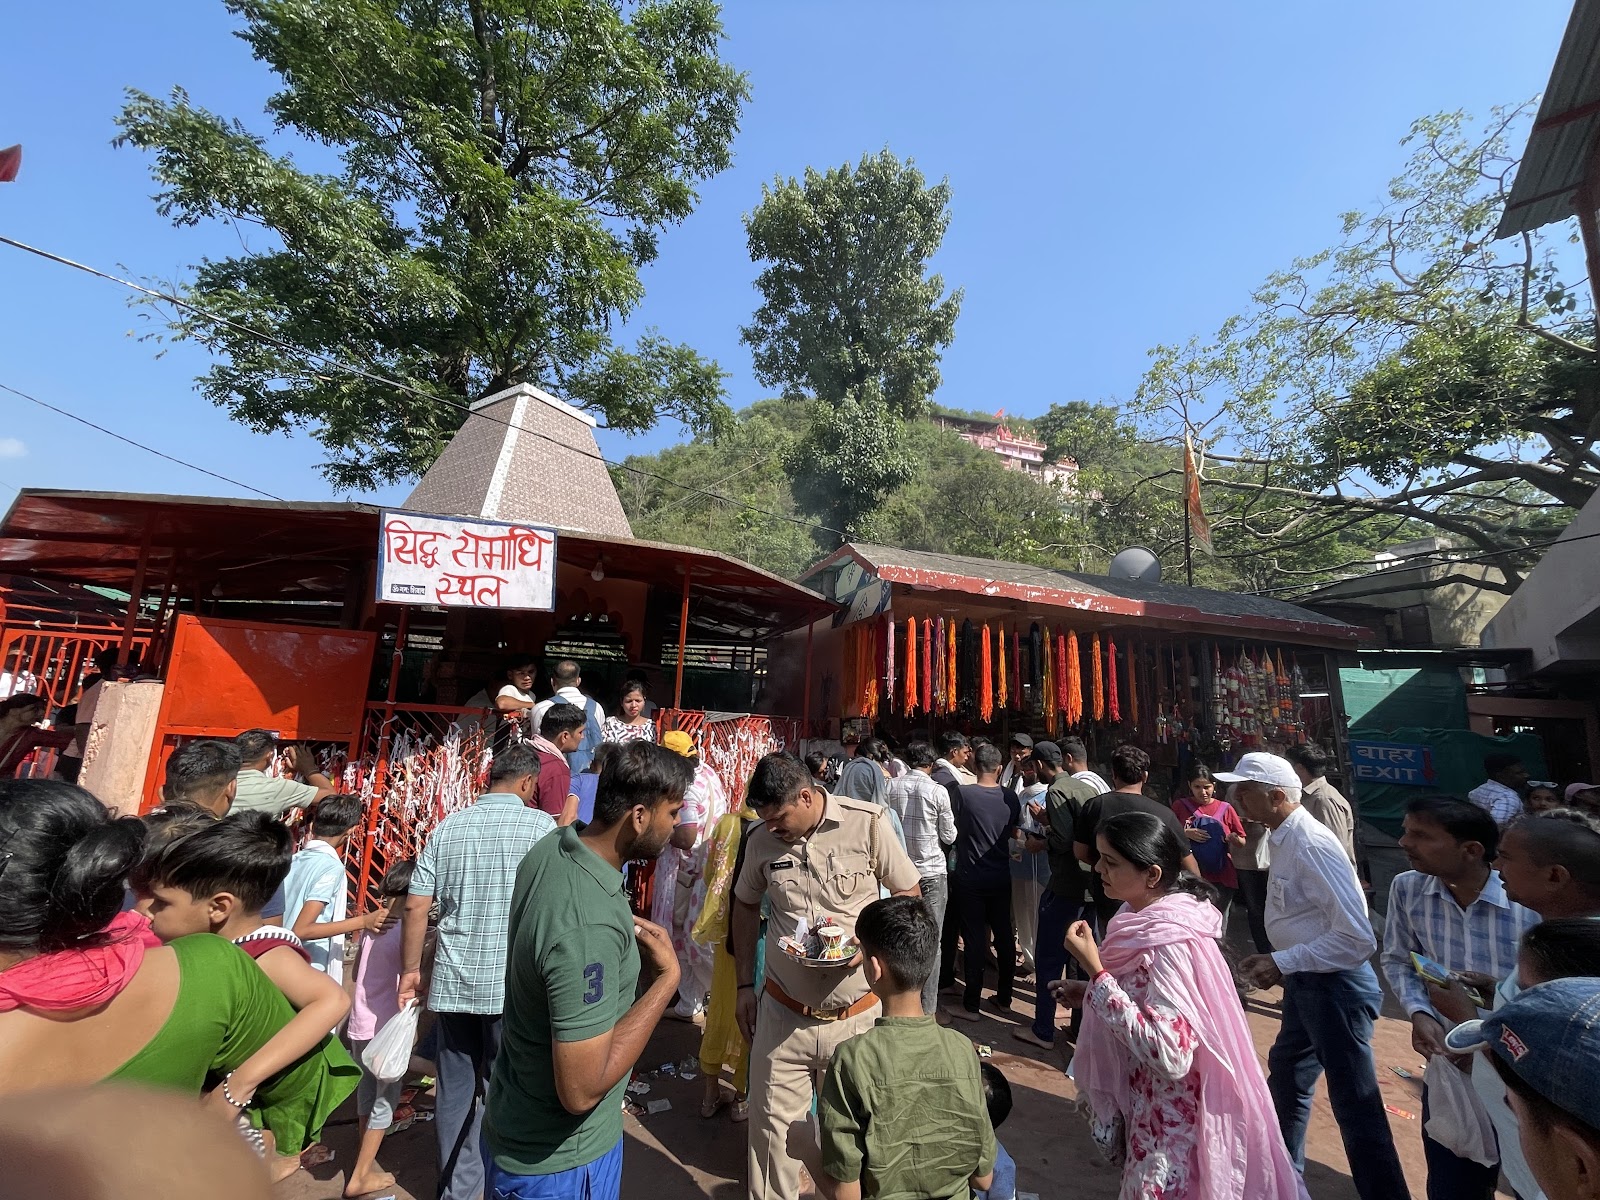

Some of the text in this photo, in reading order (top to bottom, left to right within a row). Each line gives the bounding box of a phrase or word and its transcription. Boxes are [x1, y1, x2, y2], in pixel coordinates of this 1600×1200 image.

[452, 526, 553, 571] समाधि
[435, 572, 509, 607] स्थल
[1356, 745, 1417, 763] बाहर
[1357, 764, 1417, 781] EXIT
[583, 962, 604, 1005] 3
